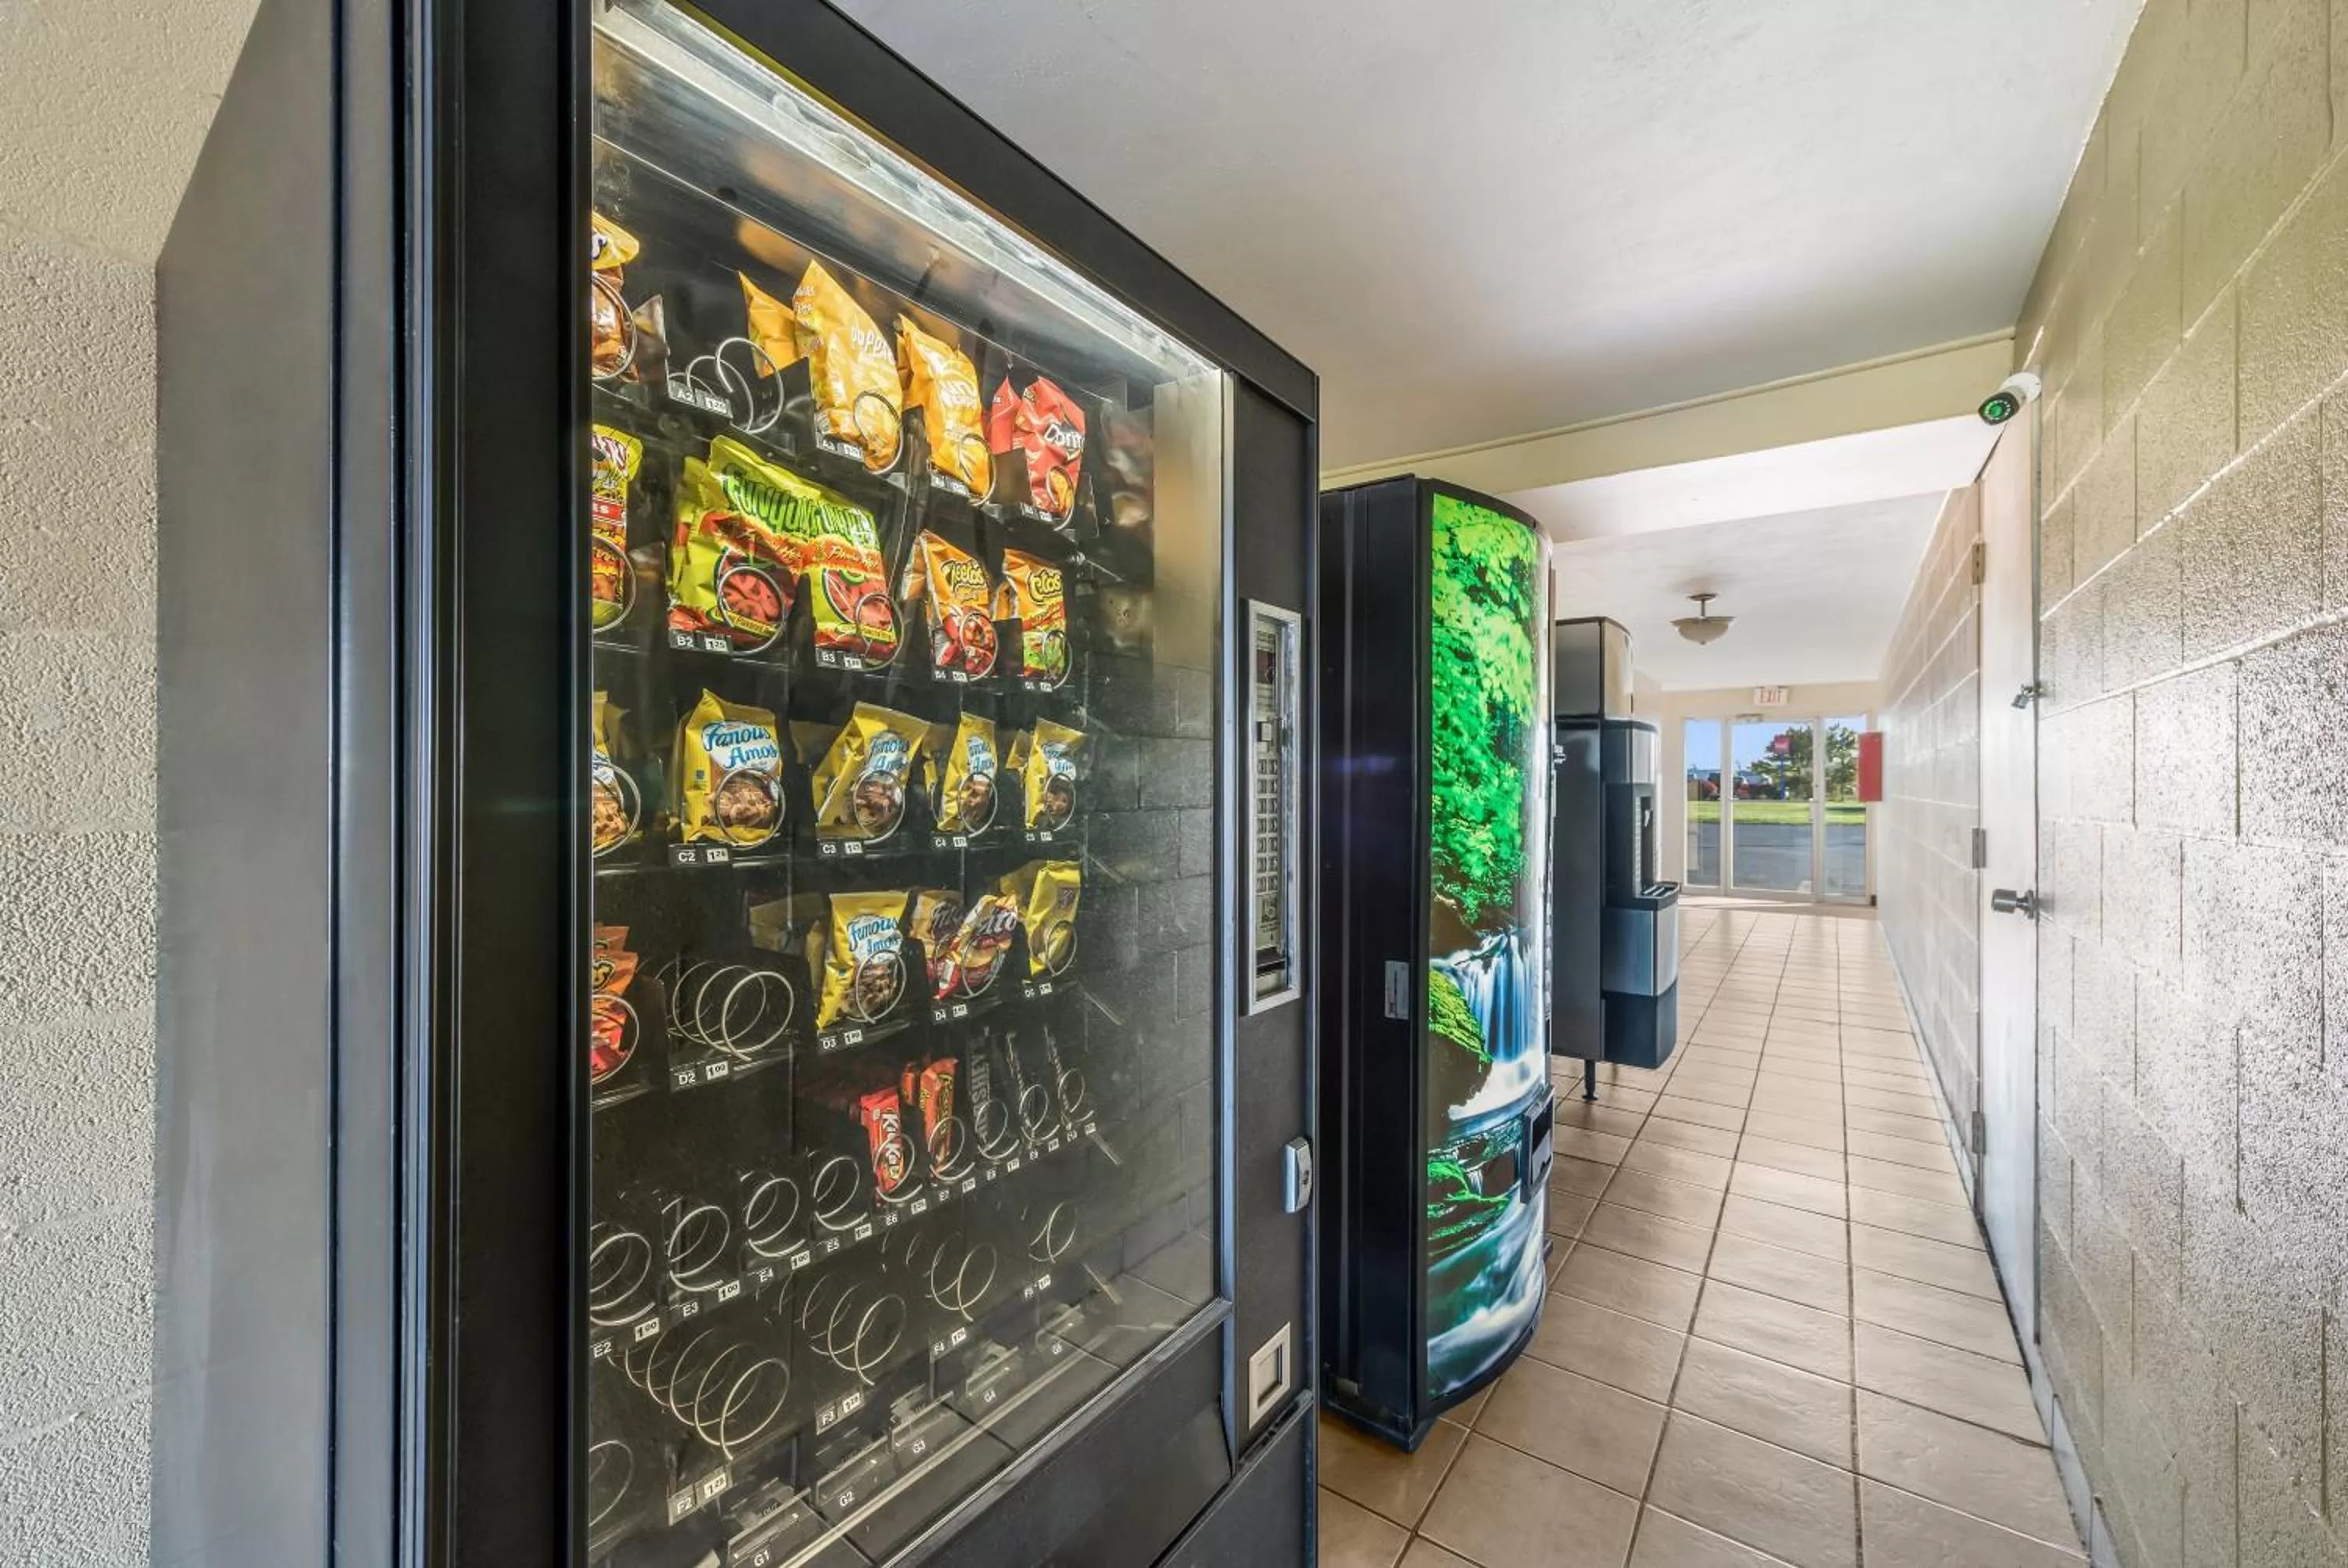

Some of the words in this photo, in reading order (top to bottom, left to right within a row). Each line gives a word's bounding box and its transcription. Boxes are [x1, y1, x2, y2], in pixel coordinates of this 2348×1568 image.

[677, 635, 694, 647] B2
[1759, 690, 1782, 703] EXIT
[702, 722, 771, 752] Famous
[723, 744, 778, 769] Amos
[823, 845, 837, 854] C3
[679, 852, 696, 862] C2
[822, 1037, 837, 1049] D3
[679, 1073, 696, 1085] D2
[885, 1215, 899, 1226] E6
[826, 1239, 840, 1253] E5
[759, 1268, 774, 1282] E4
[682, 1302, 699, 1317] E3
[593, 1342, 612, 1358] E2
[821, 1411, 835, 1426] F3
[913, 1440, 926, 1455] G3
[676, 1498, 693, 1514] F2
[839, 1491, 855, 1507] G2
[754, 1549, 769, 1567] G1
